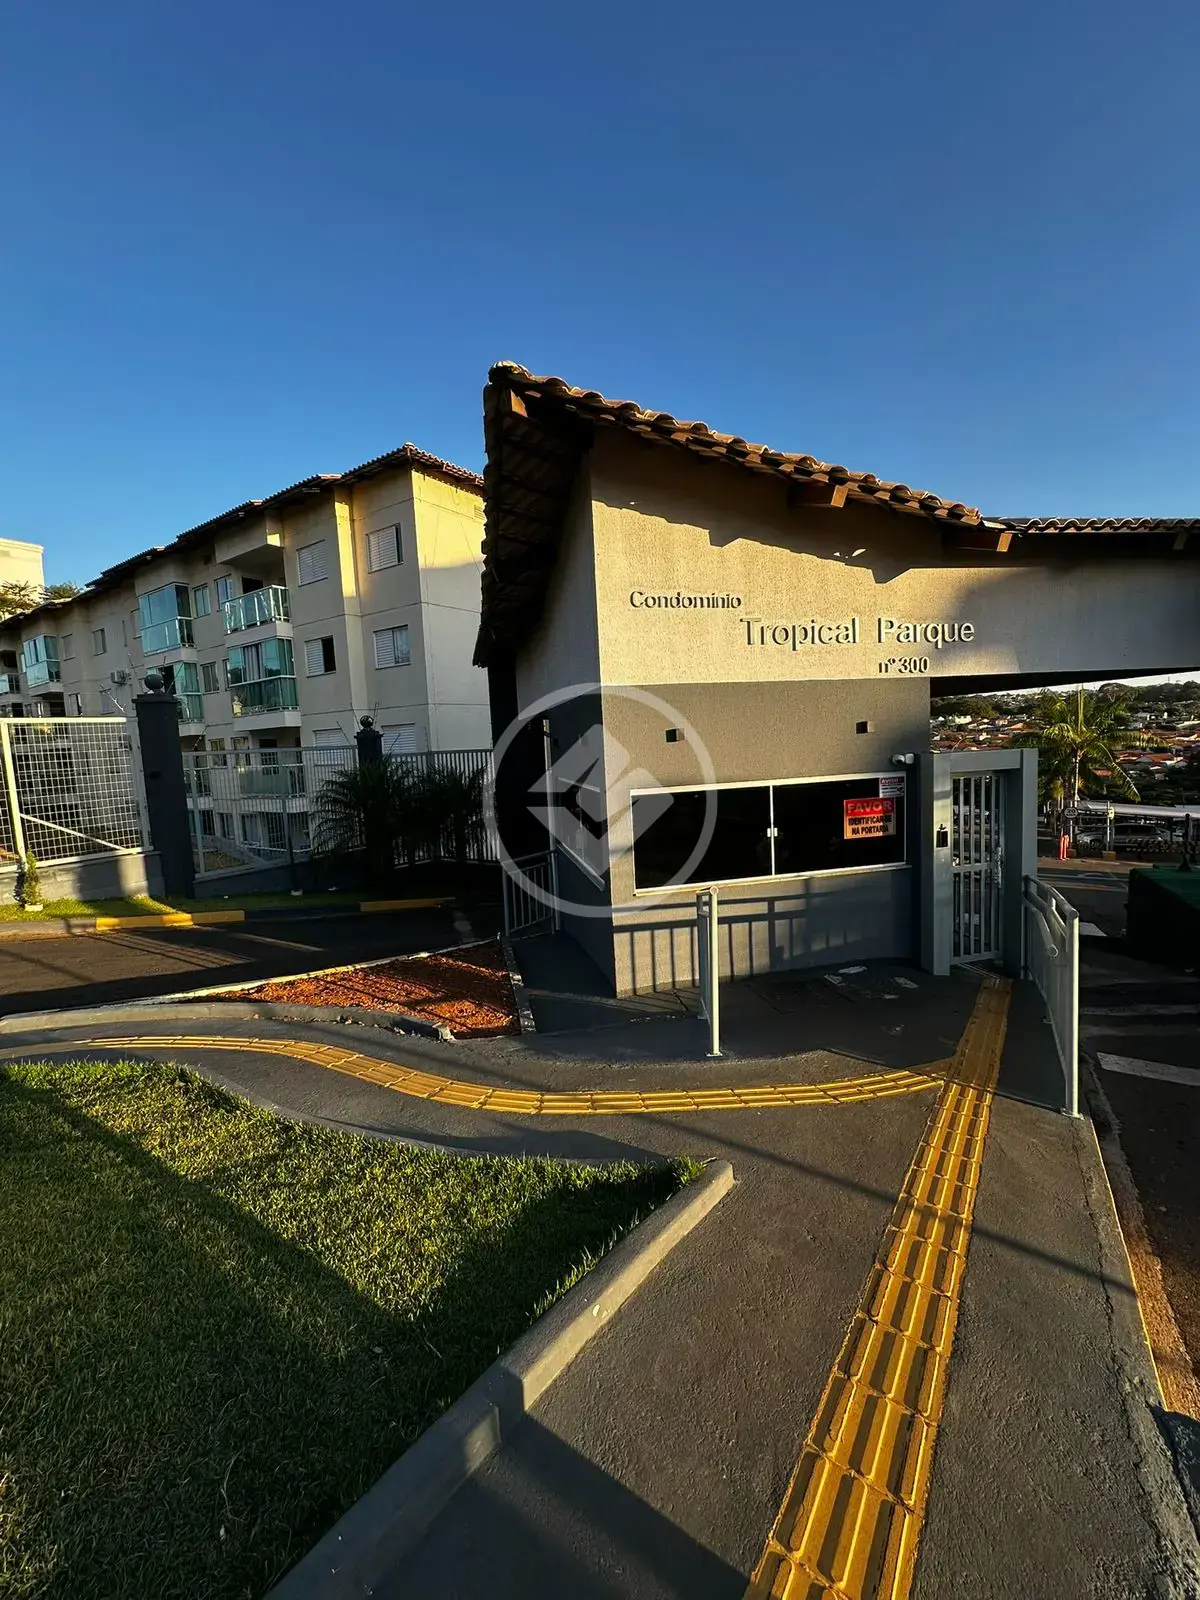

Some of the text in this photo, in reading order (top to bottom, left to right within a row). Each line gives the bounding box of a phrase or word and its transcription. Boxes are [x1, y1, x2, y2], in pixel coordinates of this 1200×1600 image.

[739, 617, 975, 651] Tropical Parque
[847, 800, 892, 813] FAVOR
[852, 825, 889, 836] NA PORTARIA
